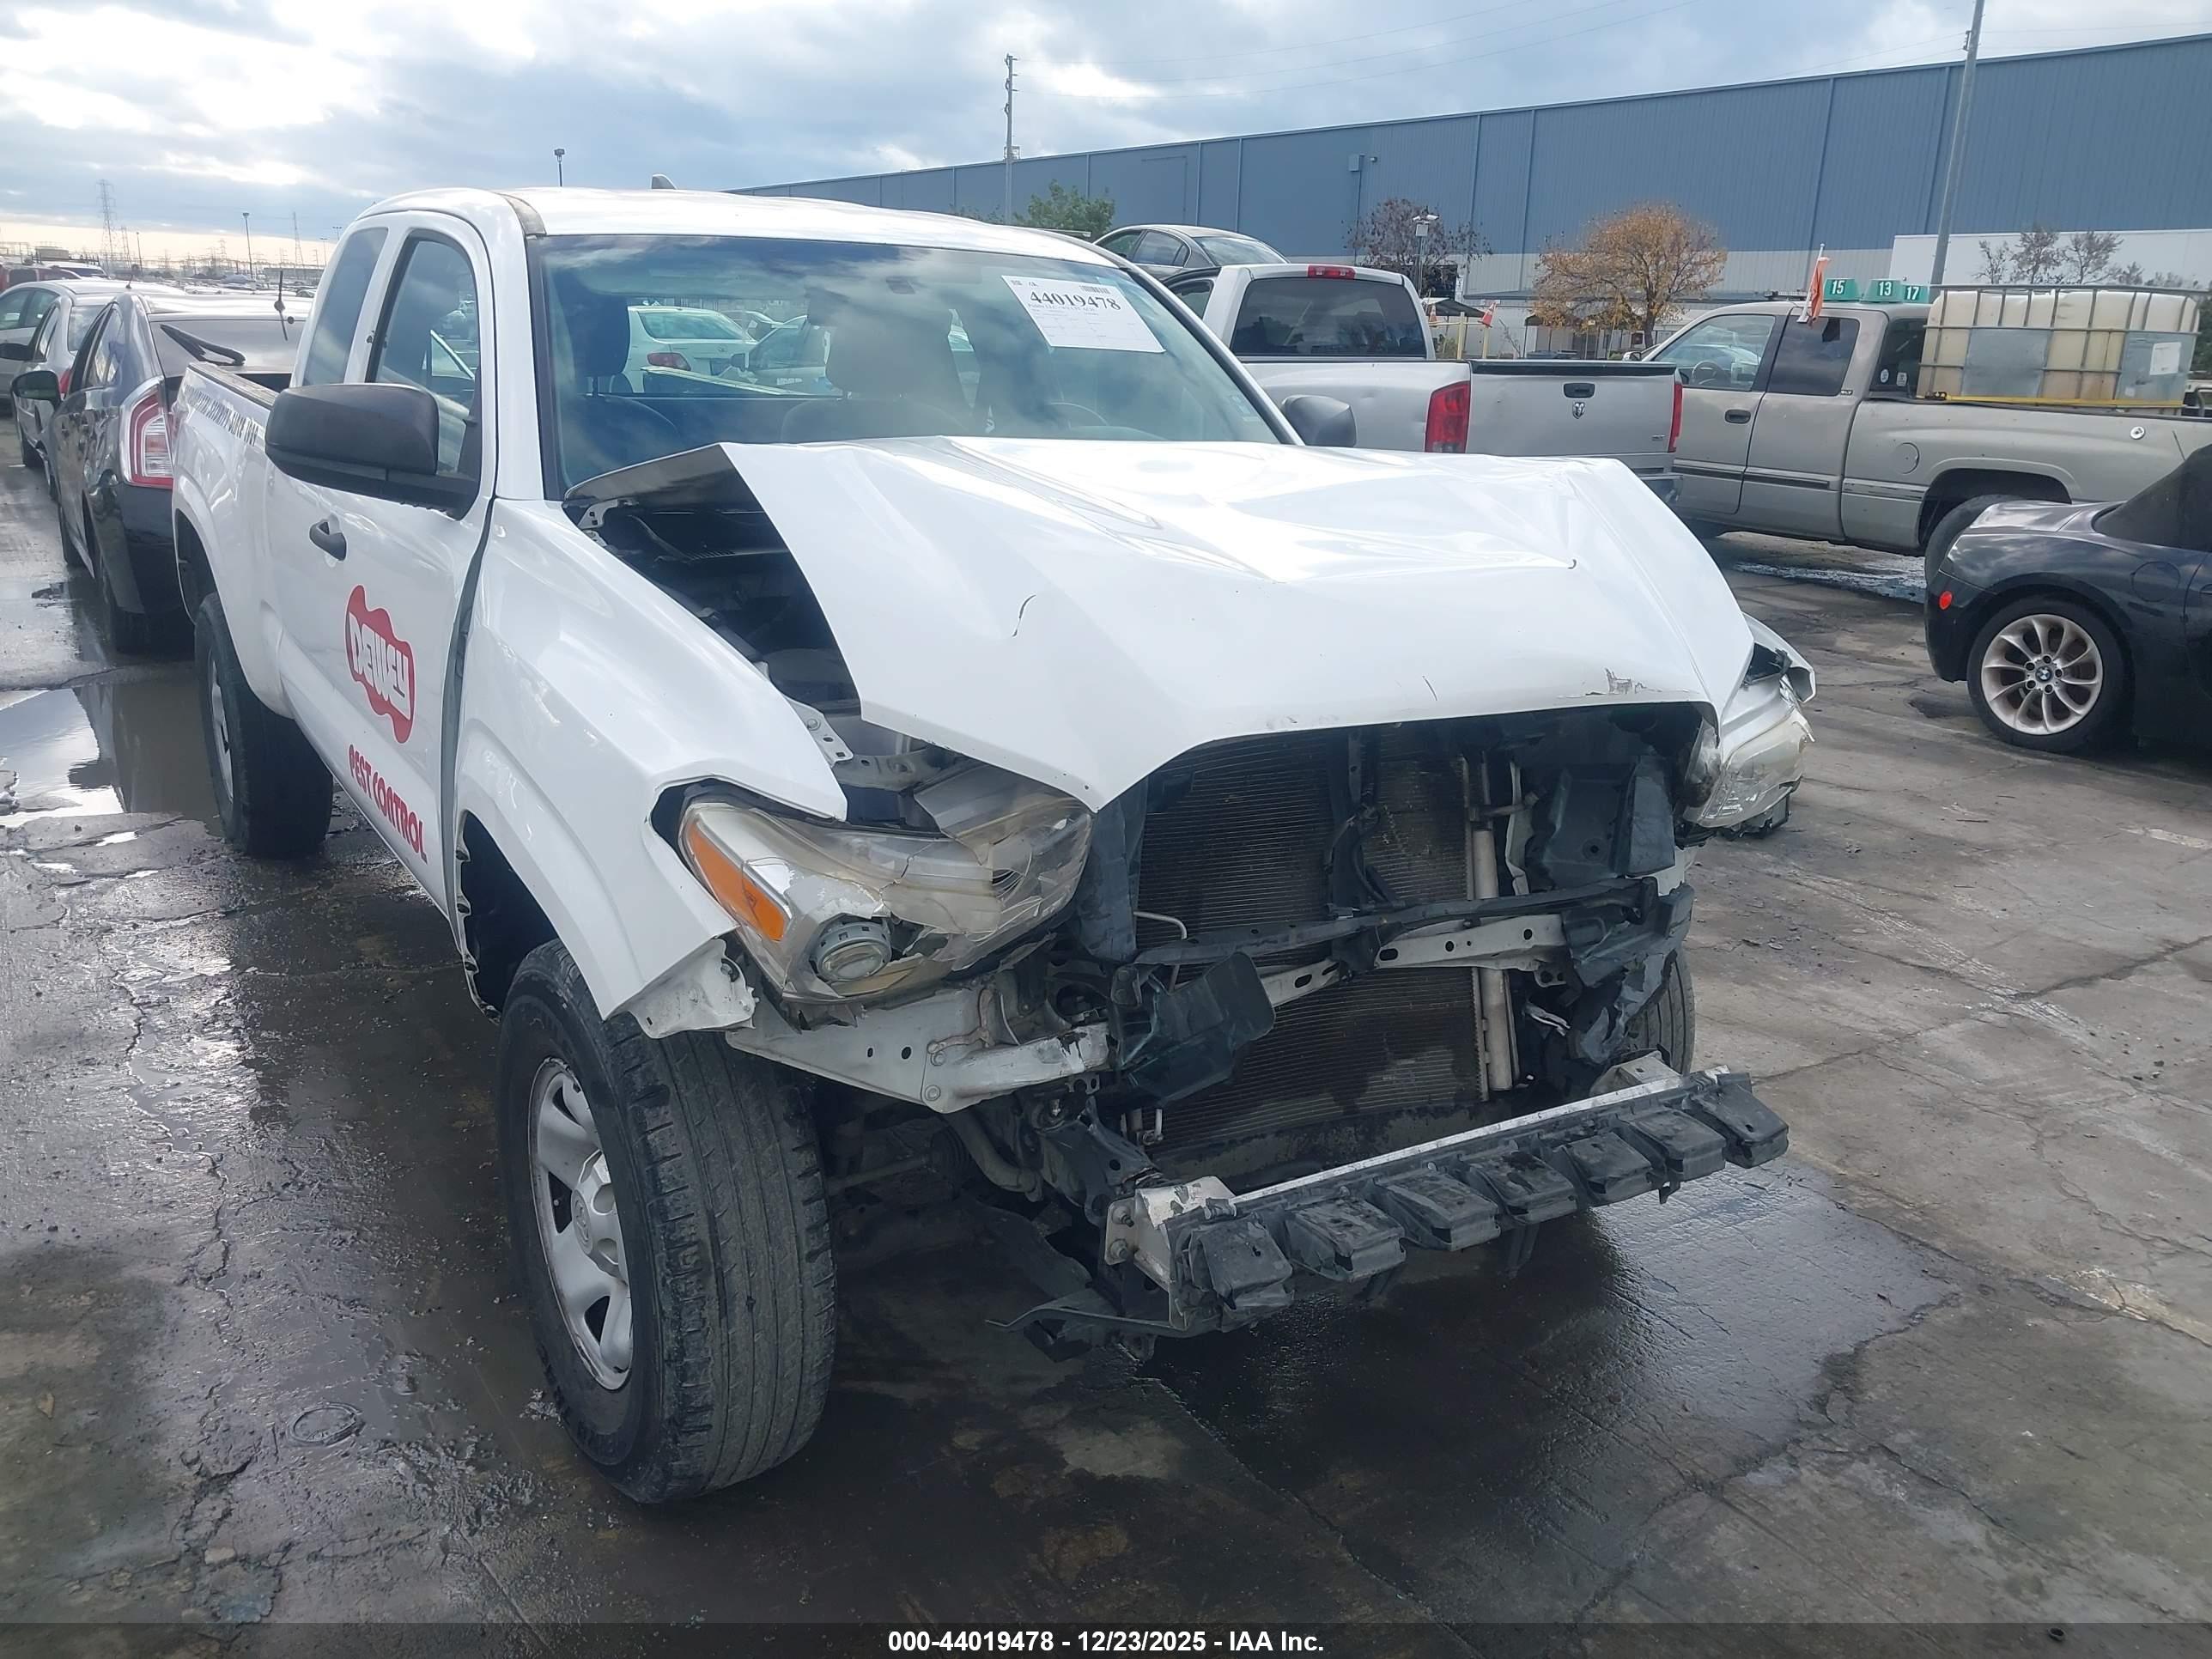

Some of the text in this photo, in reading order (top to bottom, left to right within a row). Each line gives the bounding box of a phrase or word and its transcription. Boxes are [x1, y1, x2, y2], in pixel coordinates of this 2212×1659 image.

[1832, 280, 1844, 294] 15
[1879, 282, 1892, 295] 13
[1906, 286, 1919, 300] 17
[1030, 291, 1121, 311] 44019478
[349, 744, 428, 864] PEST CONTROL
